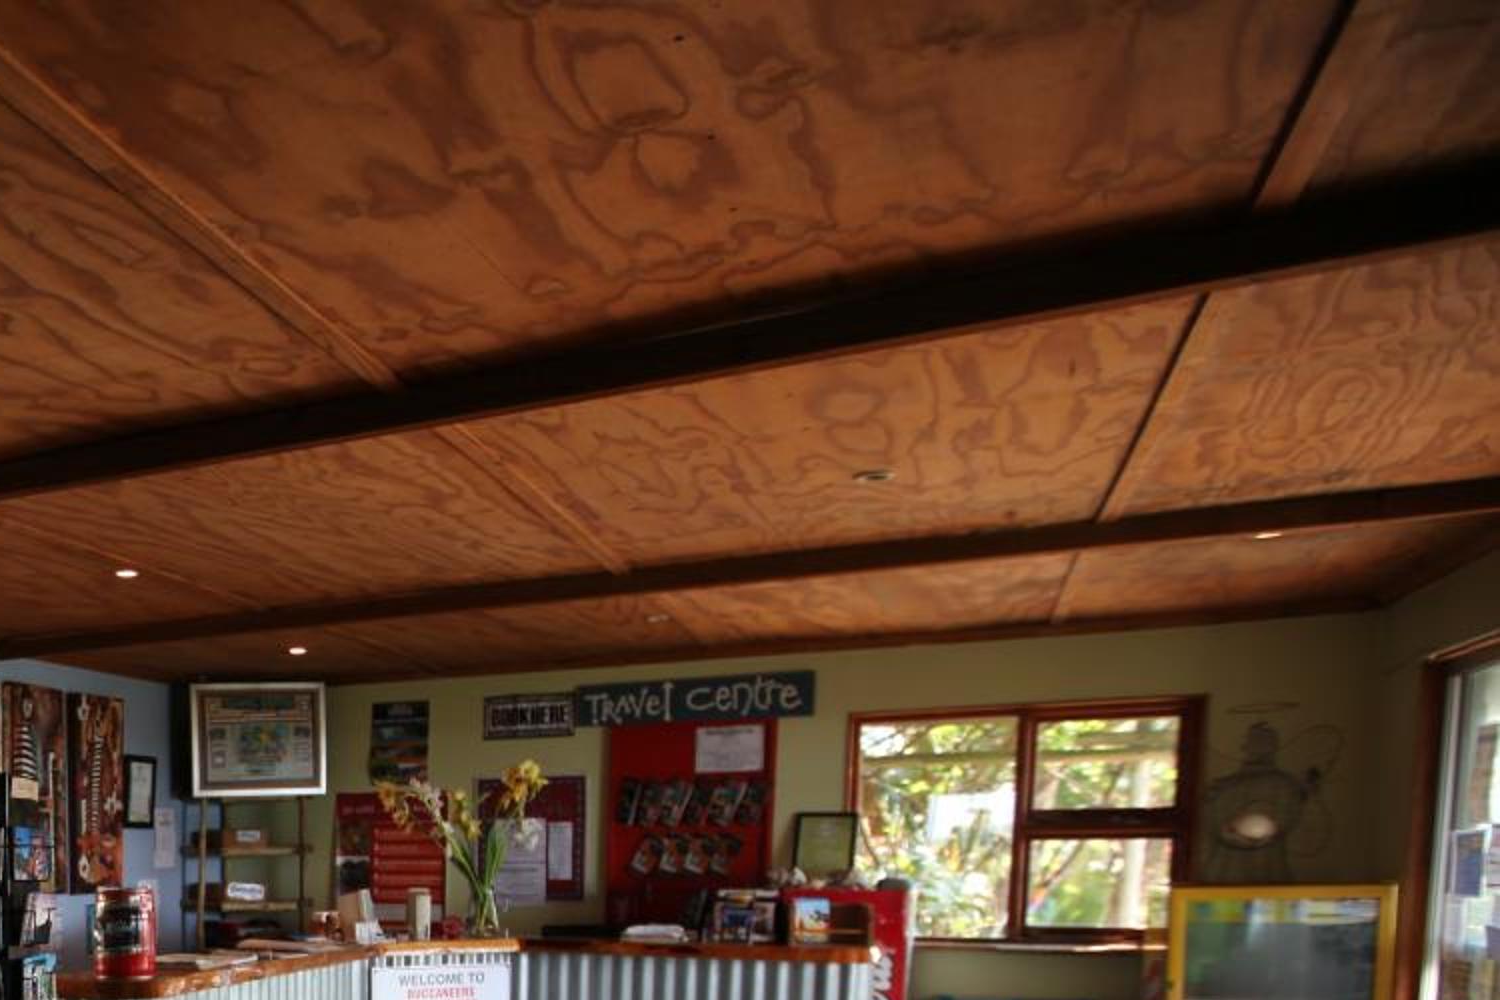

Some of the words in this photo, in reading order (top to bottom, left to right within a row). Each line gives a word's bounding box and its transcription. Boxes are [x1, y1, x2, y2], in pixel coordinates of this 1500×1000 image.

[399, 973, 464, 987] WELCOME
[468, 971, 485, 984] TO
[407, 986, 476, 1000] BUCCANEERS
